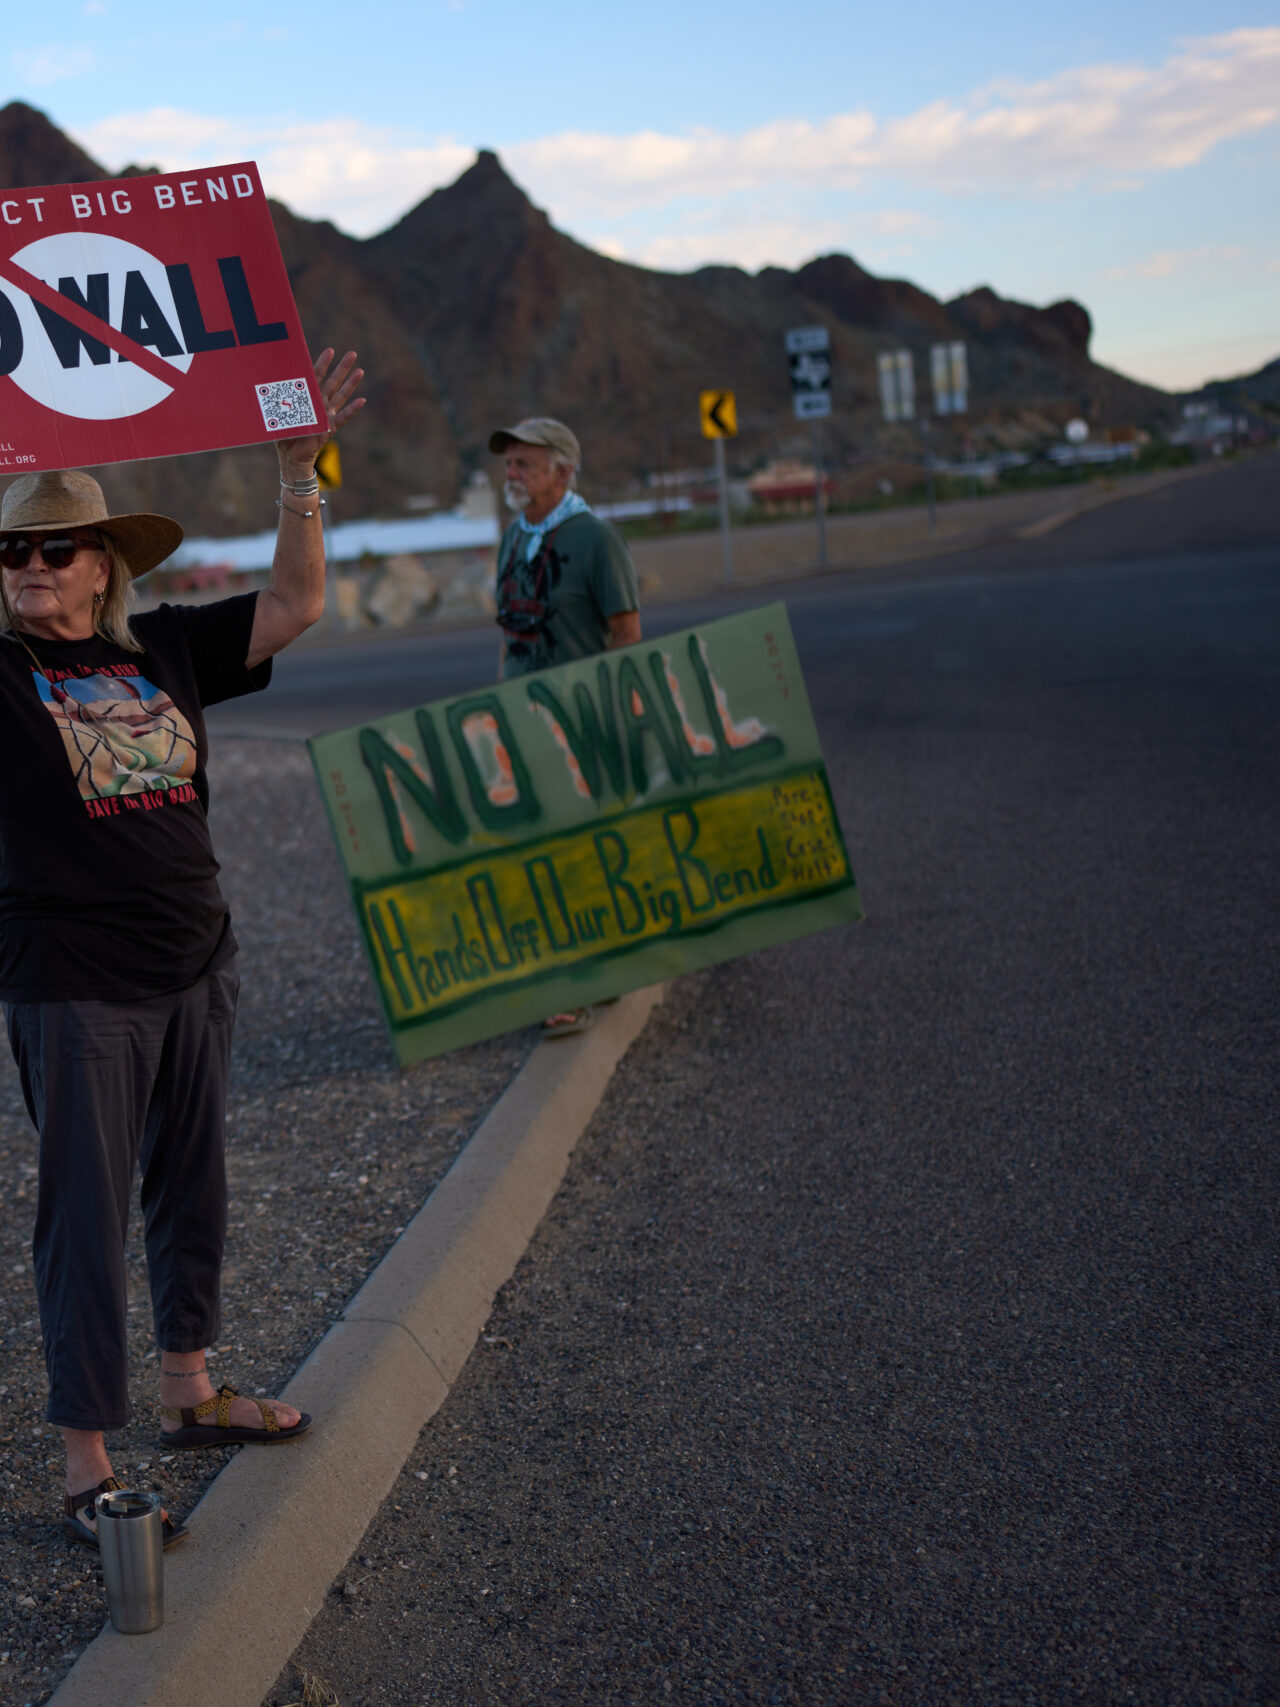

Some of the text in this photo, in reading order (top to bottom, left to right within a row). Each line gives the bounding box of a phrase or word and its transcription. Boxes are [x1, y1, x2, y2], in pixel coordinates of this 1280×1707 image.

[71, 190, 132, 219] BIG
[154, 173, 255, 210] BEND
[29, 255, 289, 370] WALL
[85, 797, 120, 819] SAVE
[141, 790, 164, 811] RIO
[359, 633, 786, 866] NO WALL
[369, 898, 490, 1010] Hands
[524, 854, 610, 953] Our
[592, 829, 682, 935] Big
[663, 806, 779, 914] Bend
